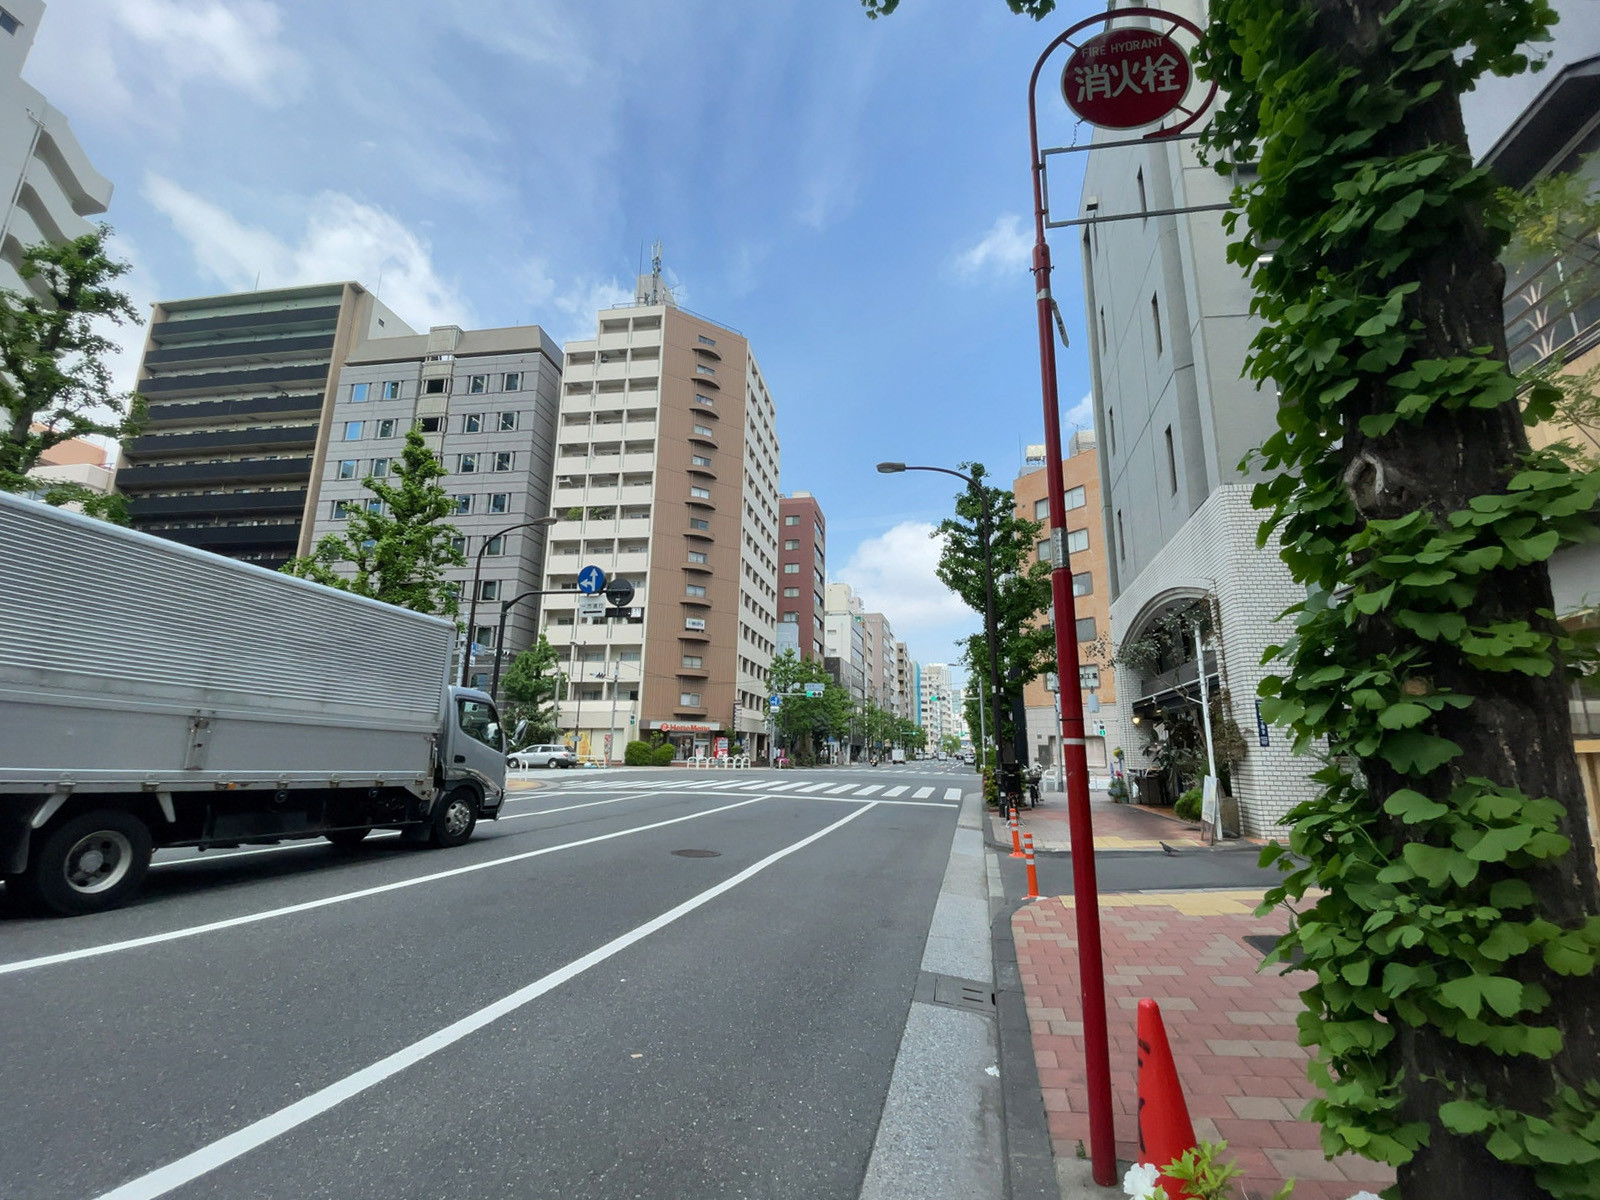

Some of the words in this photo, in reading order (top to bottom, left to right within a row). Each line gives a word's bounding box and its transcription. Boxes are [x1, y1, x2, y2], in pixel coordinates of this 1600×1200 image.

[1082, 45, 1106, 58] FIRE
[1110, 37, 1164, 54] HYDRANT
[1074, 53, 1181, 103] 消火栓
